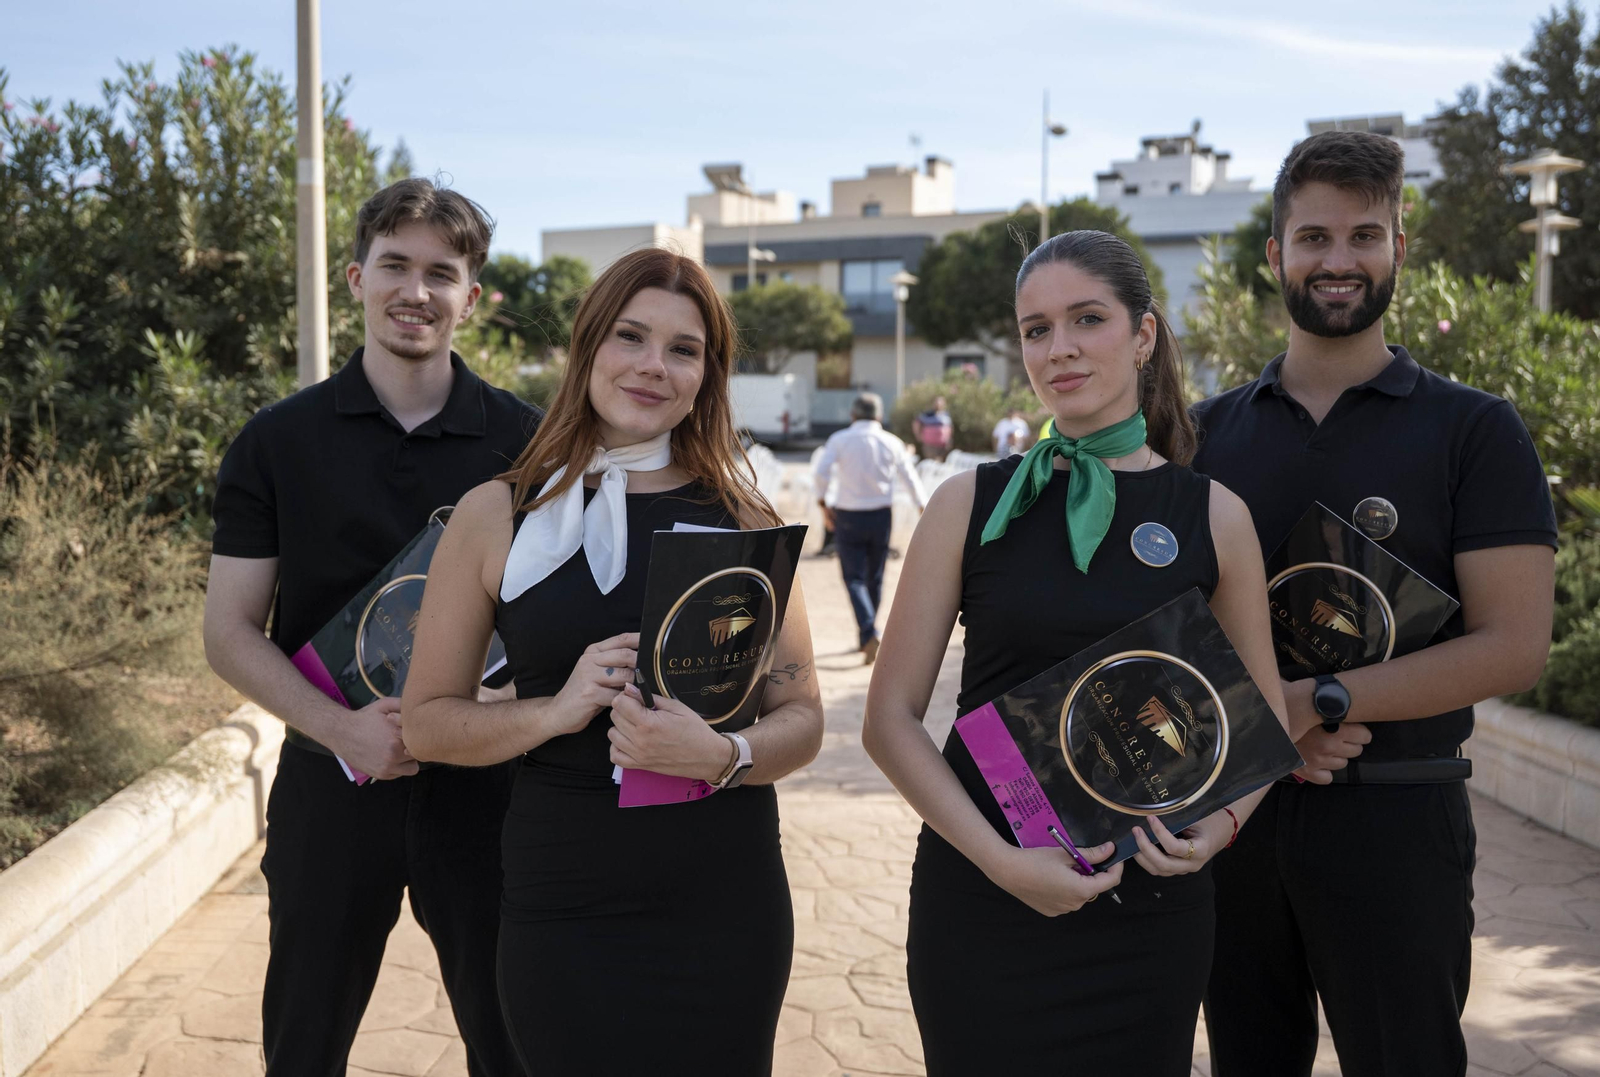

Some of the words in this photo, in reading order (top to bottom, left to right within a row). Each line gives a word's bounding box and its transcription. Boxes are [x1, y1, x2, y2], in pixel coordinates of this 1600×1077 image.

[377, 607, 412, 660] CONGR
[669, 644, 764, 668] CONGRESUR
[1269, 601, 1352, 668] CONGRESU
[1095, 681, 1169, 799] CONGRESUR
[1113, 727, 1137, 767] PROFESIONAL
[1141, 777, 1160, 804] EVENTOS
